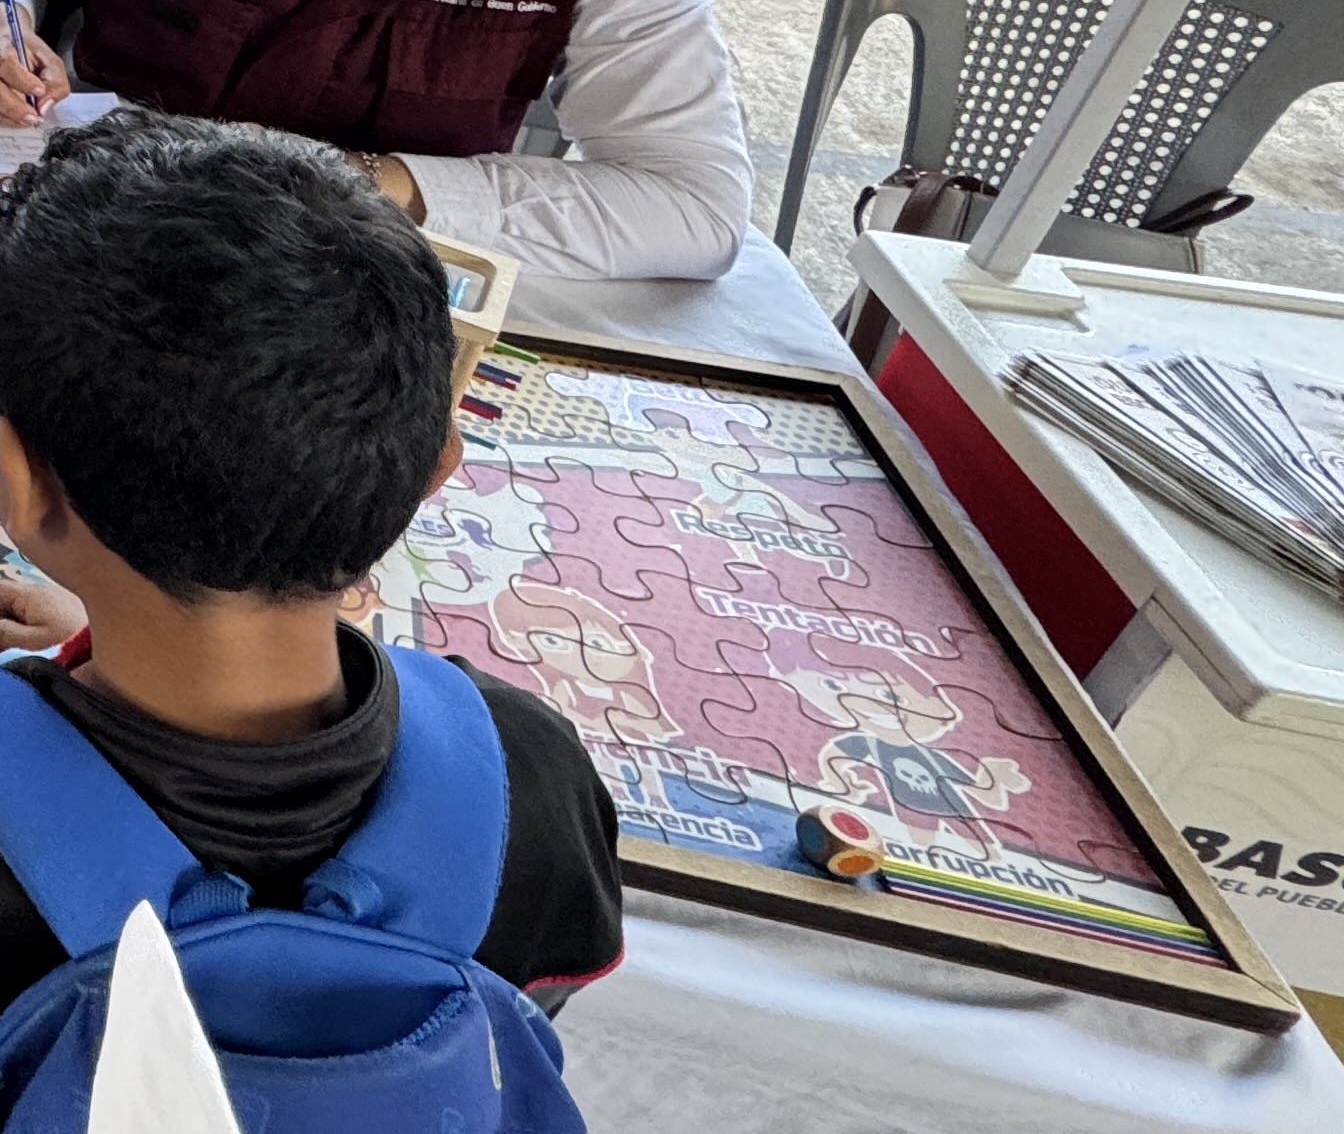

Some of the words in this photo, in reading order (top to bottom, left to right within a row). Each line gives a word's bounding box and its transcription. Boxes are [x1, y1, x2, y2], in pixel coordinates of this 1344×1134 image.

[517, 0, 558, 14] Gobierno
[674, 509, 852, 561] Respeto
[700, 590, 942, 656] Tentación
[883, 840, 1075, 898] orrupción
[1208, 874, 1253, 896] EL
